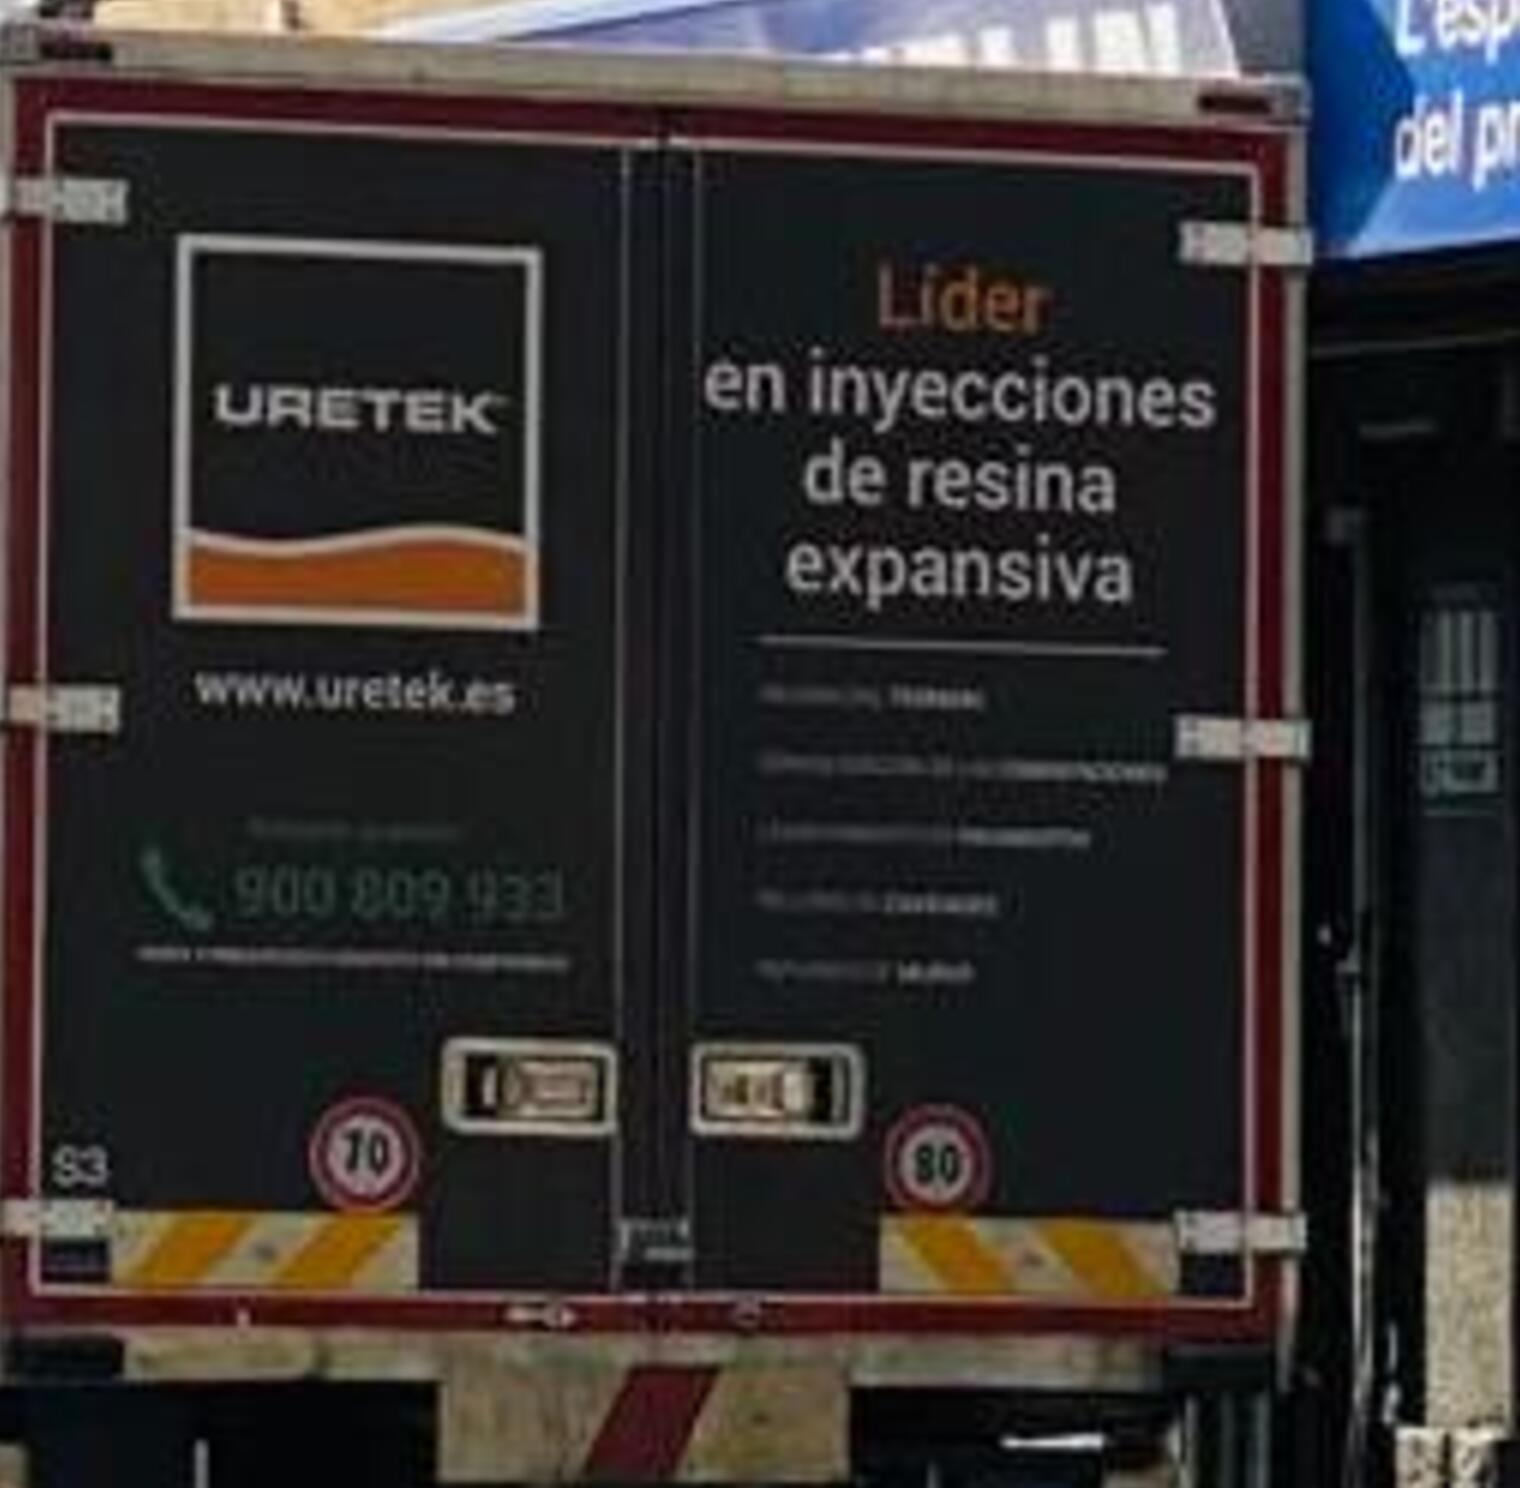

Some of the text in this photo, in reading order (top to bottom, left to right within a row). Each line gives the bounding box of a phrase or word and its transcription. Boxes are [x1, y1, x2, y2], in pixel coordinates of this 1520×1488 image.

[1394, 84, 1461, 176] del
[212, 384, 500, 434] URETEK
[703, 346, 1219, 433] en inyecciones
[802, 436, 1117, 513] de resina
[785, 532, 1135, 613] expansiva
[192, 669, 518, 714] www.uretek.es
[51, 1144, 110, 1186] S3
[912, 1142, 960, 1185] 80
